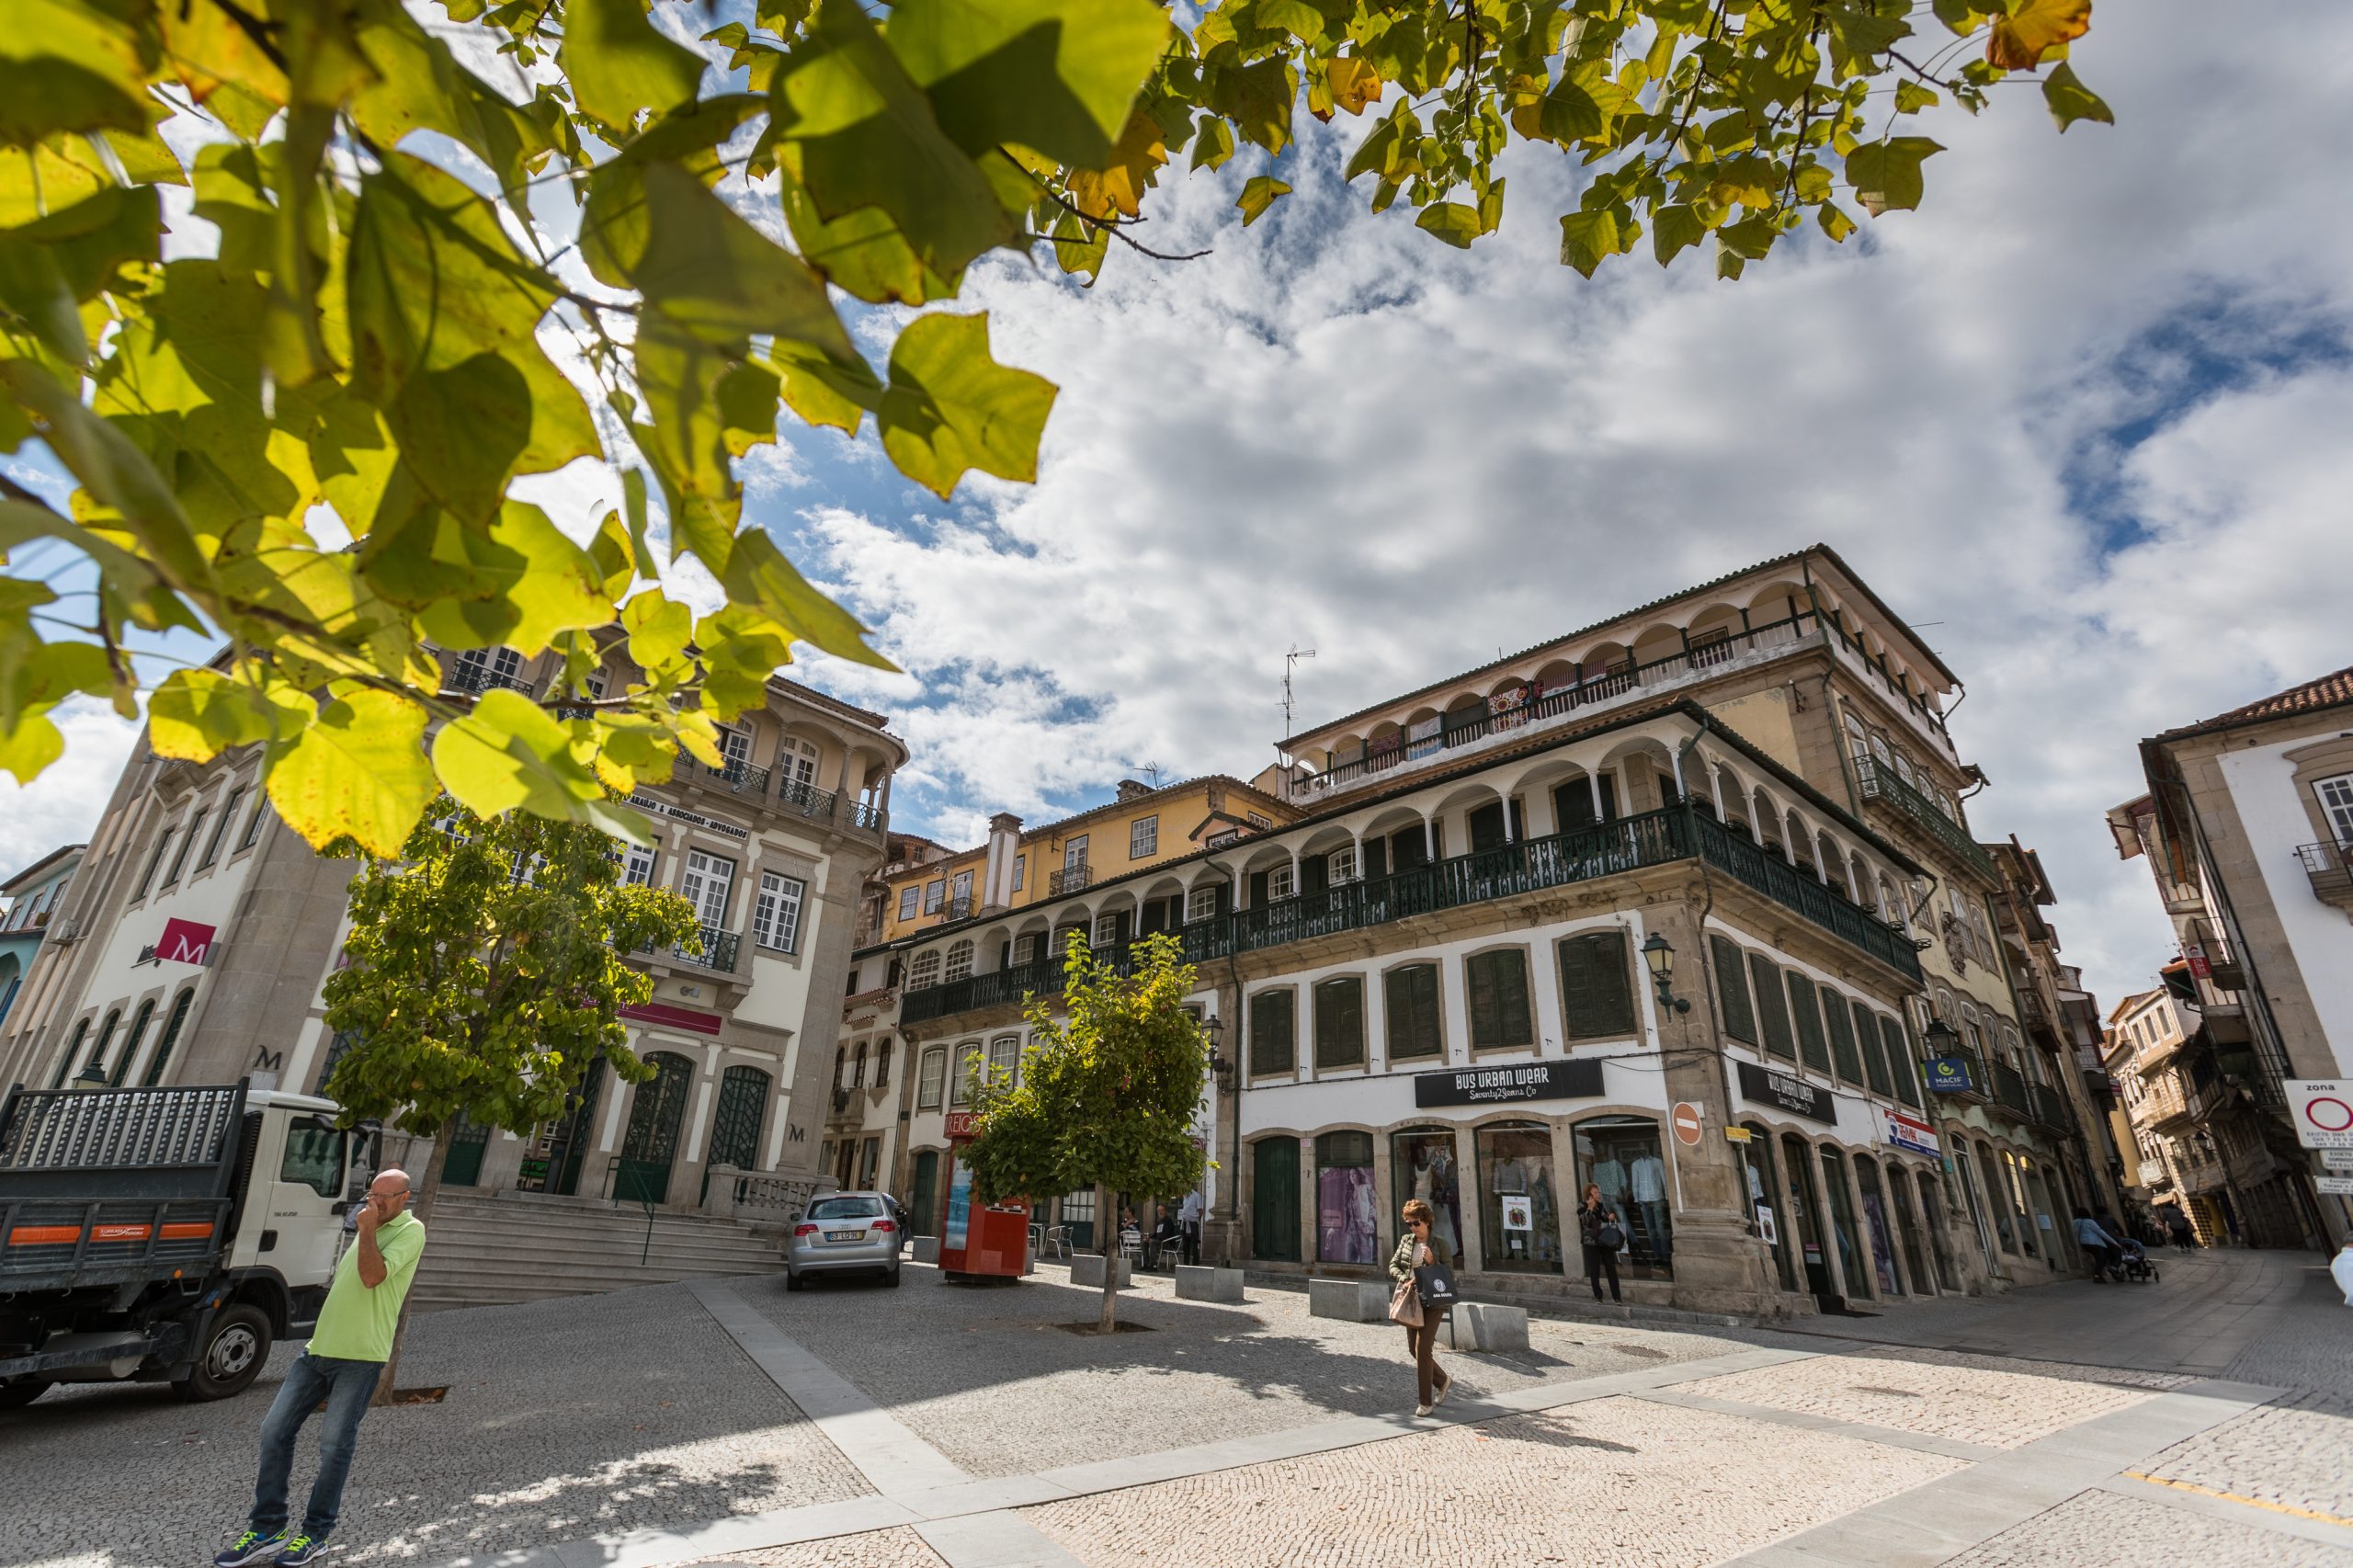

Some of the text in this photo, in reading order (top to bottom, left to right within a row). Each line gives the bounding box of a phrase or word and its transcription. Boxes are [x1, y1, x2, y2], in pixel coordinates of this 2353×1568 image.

[630, 795, 656, 810] ARAÚJO
[667, 807, 706, 825] ASSOCIADOS
[709, 822, 747, 838] ADVOGADOS
[171, 933, 206, 965] M
[255, 1044, 283, 1070] M
[1455, 1074, 1476, 1090] BUS
[1478, 1070, 1514, 1088] URBAN
[789, 1123, 804, 1142] M
